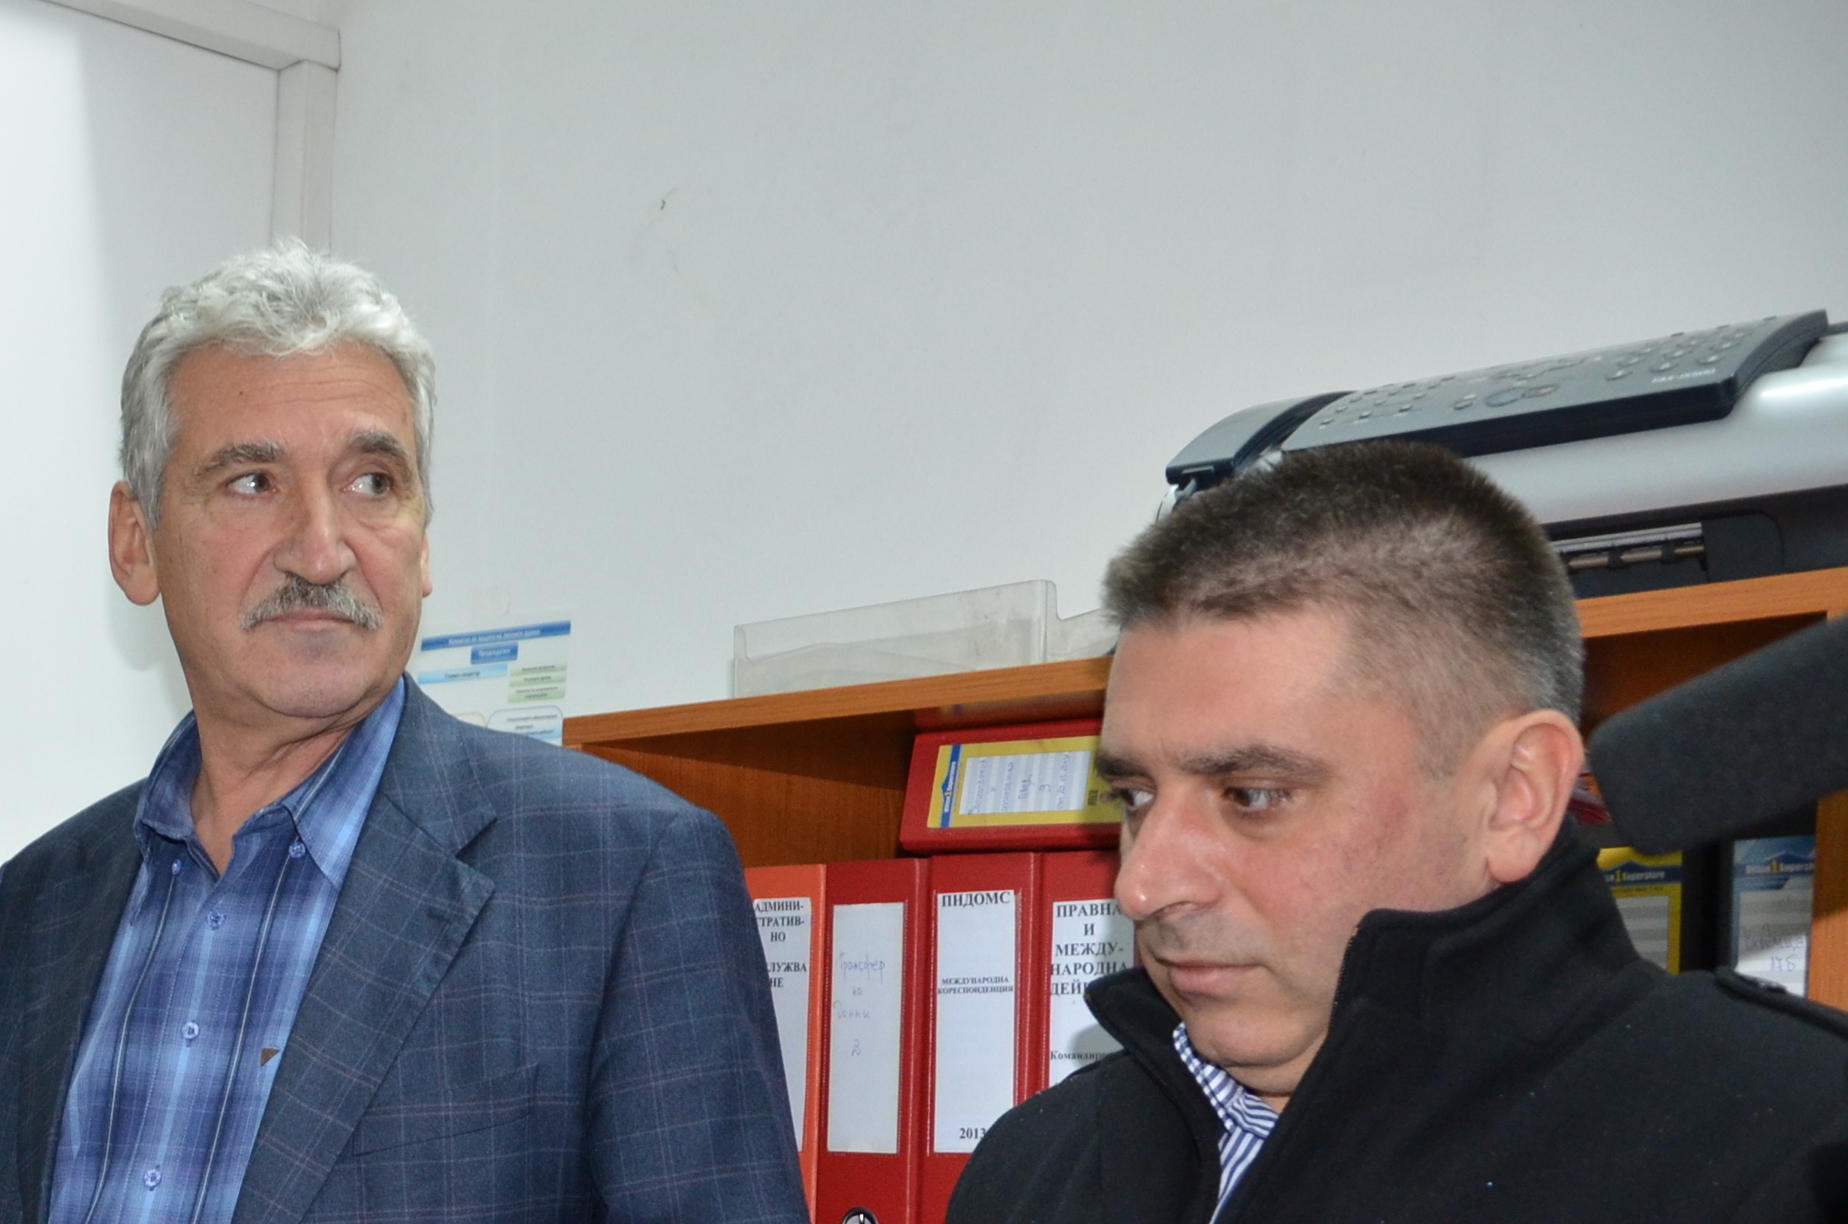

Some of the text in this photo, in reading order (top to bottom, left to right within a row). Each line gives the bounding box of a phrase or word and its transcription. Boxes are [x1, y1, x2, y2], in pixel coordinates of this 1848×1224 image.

[941, 891, 1011, 908] ПНДОМС
[756, 915, 805, 928] ТРАТИВ-
[1083, 923, 1095, 936] И
[770, 931, 786, 942] НО
[1055, 942, 1124, 957] МЕЖДУ-
[767, 962, 807, 973] ЛУЖВА
[959, 1127, 986, 1140] 2013
